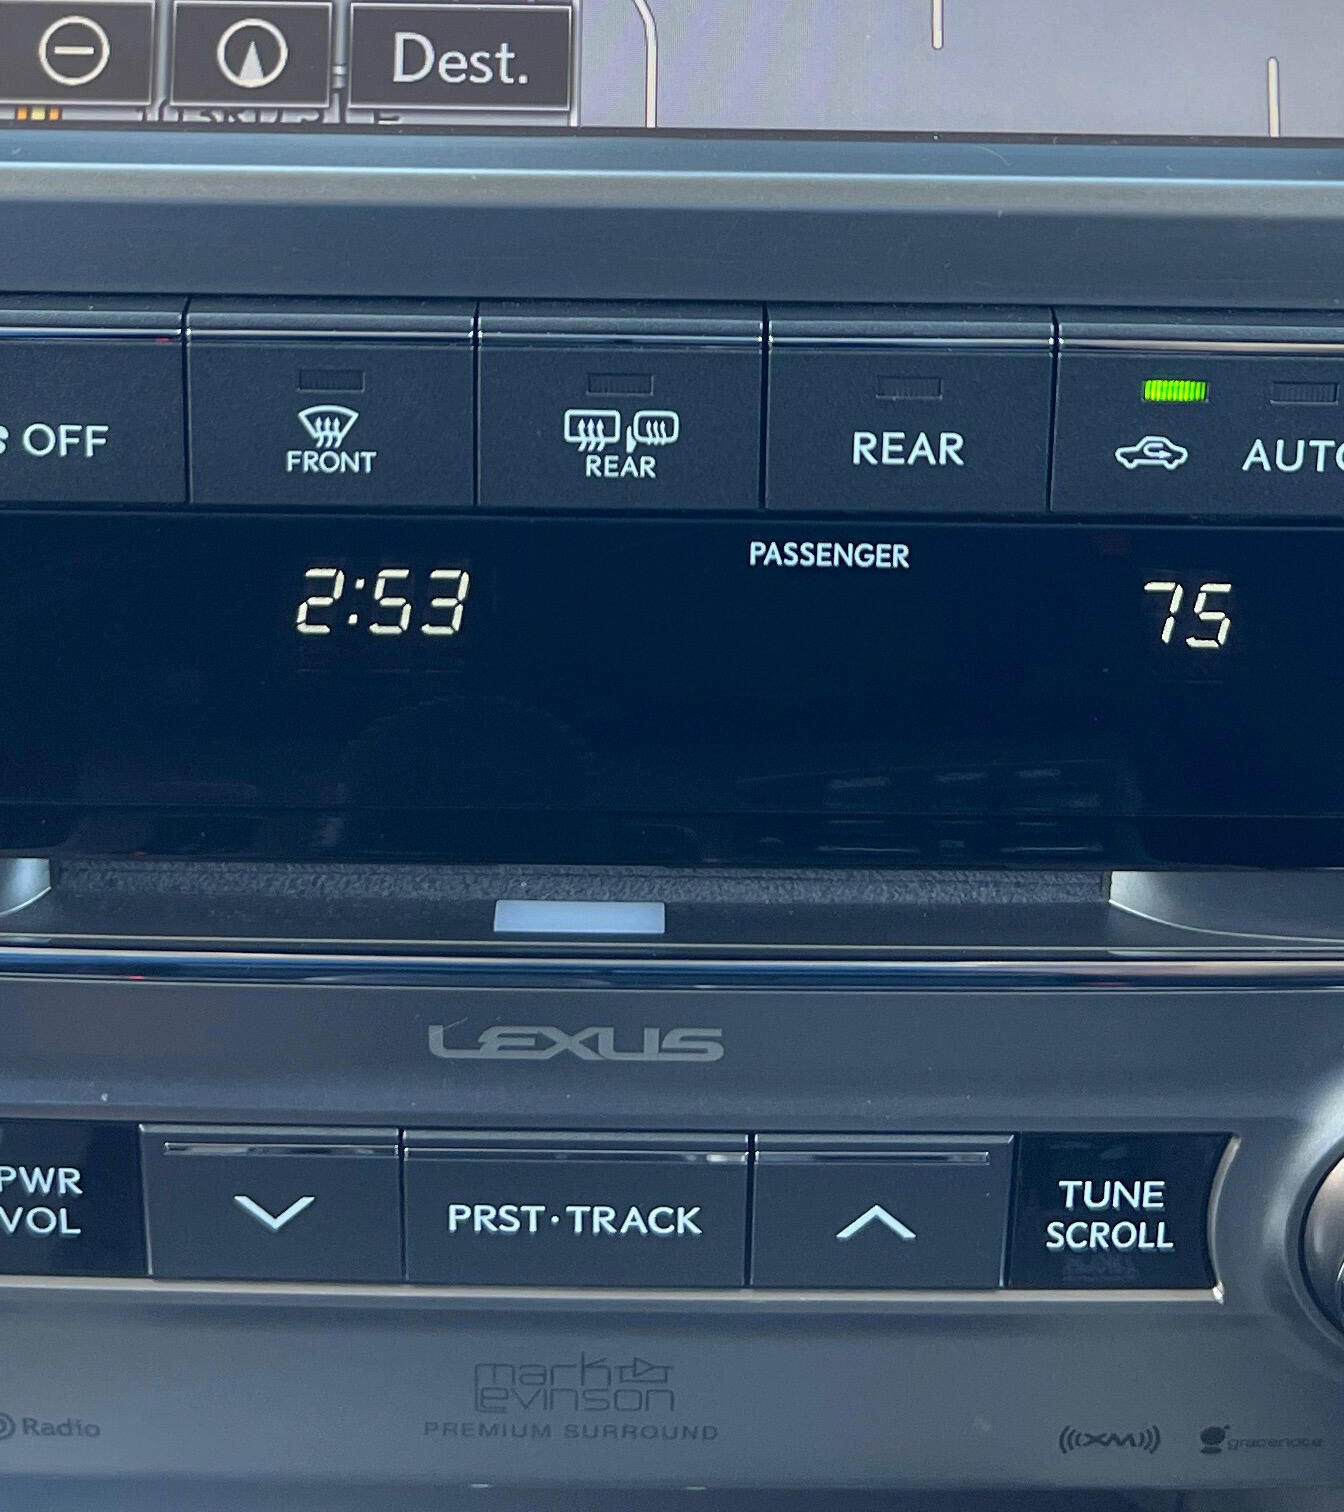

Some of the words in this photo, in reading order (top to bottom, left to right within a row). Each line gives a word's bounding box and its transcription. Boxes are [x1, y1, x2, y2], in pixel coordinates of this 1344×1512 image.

[393, 31, 528, 84] Dest.
[22, 423, 109, 458] OFF
[852, 431, 964, 466] REAR
[286, 450, 377, 474] FRONT
[585, 454, 656, 479] REAR
[749, 541, 910, 569] PASSENGER
[295, 568, 470, 635] 2:53
[1143, 581, 1232, 649] 75
[428, 1024, 725, 1062] LEXUS
[1058, 1180, 1165, 1209] TUNE
[1046, 1221, 1174, 1249] SCROLL
[22, 1416, 101, 1439] Radio
[423, 1421, 552, 1439] PREMIUM
[565, 1424, 719, 1441] SURROUND
